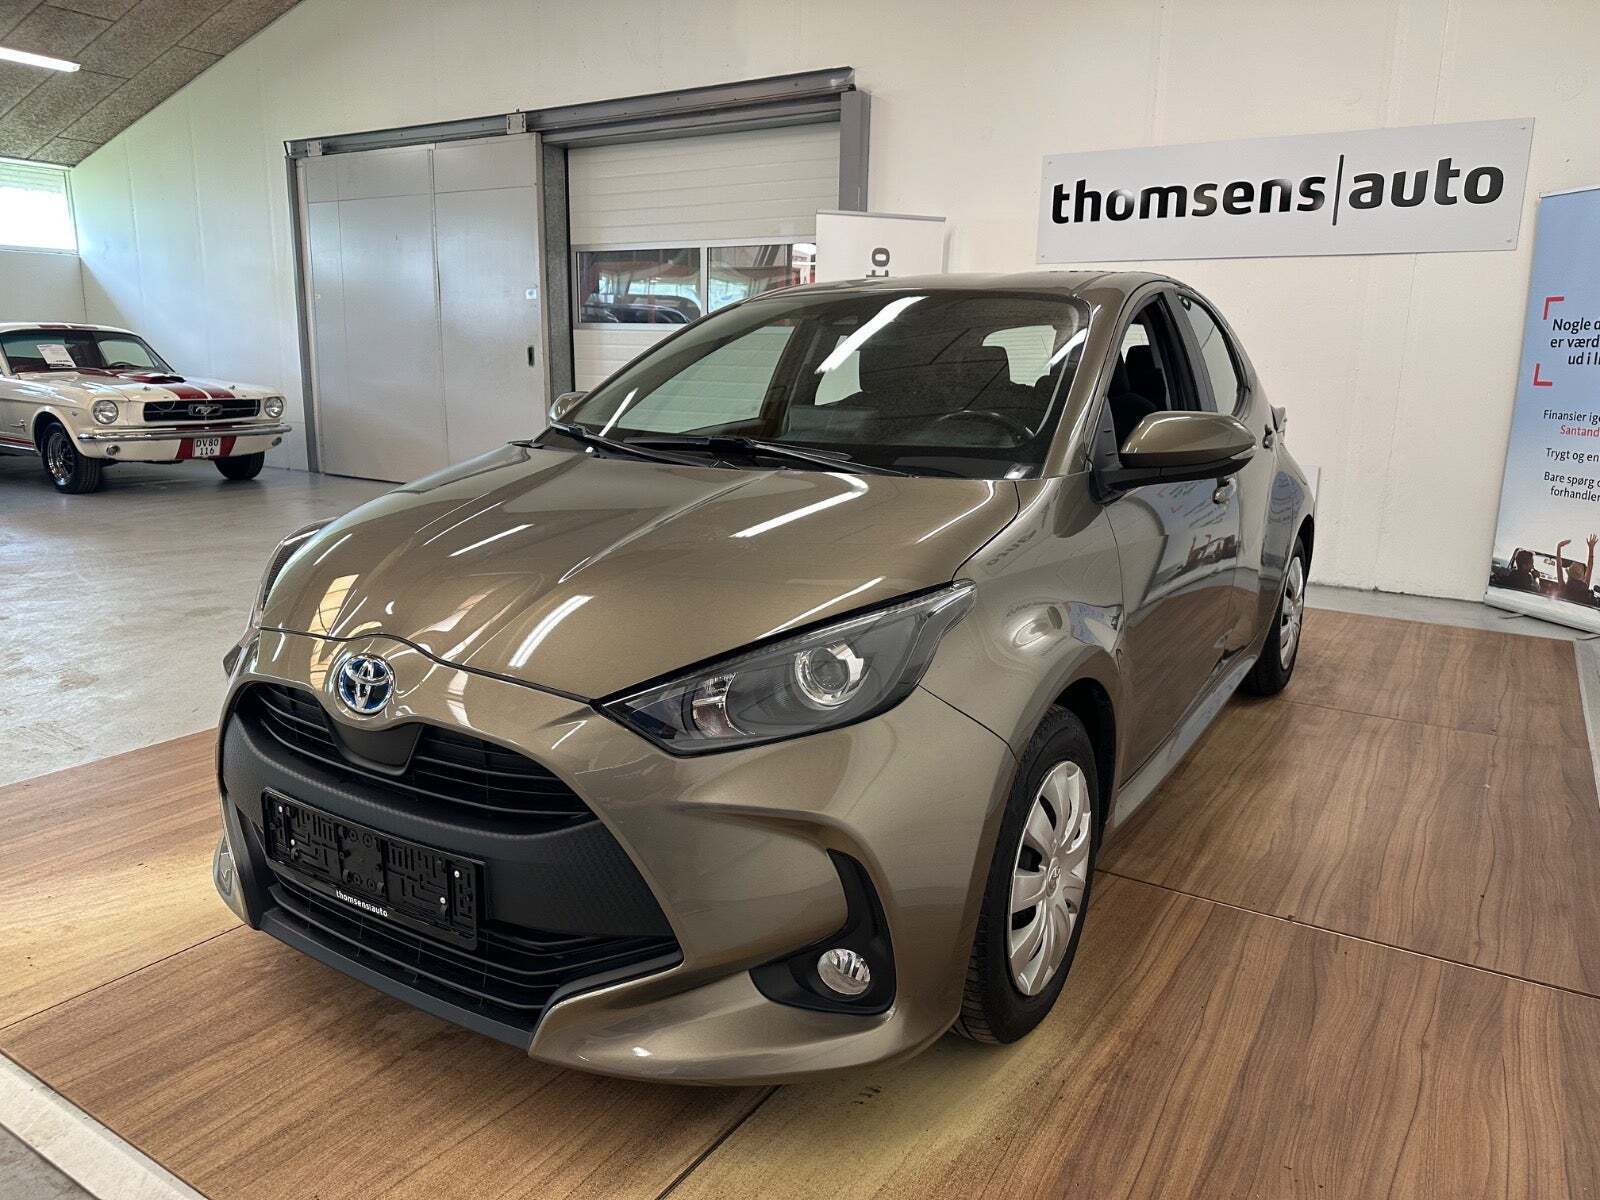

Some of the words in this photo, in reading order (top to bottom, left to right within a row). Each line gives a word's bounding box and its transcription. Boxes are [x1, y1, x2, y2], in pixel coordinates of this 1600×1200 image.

[1552, 317, 1591, 335] Nogle
[1550, 338, 1564, 348] er
[1568, 352, 1585, 365] ud
[1587, 352, 1592, 365] i
[1543, 409, 1587, 422] Finansier
[200, 447, 215, 456] 116
[1546, 447, 1570, 461] Trygt
[1572, 452, 1585, 464] og
[1543, 471, 1565, 483] Bare
[1567, 475, 1595, 490] spørg
